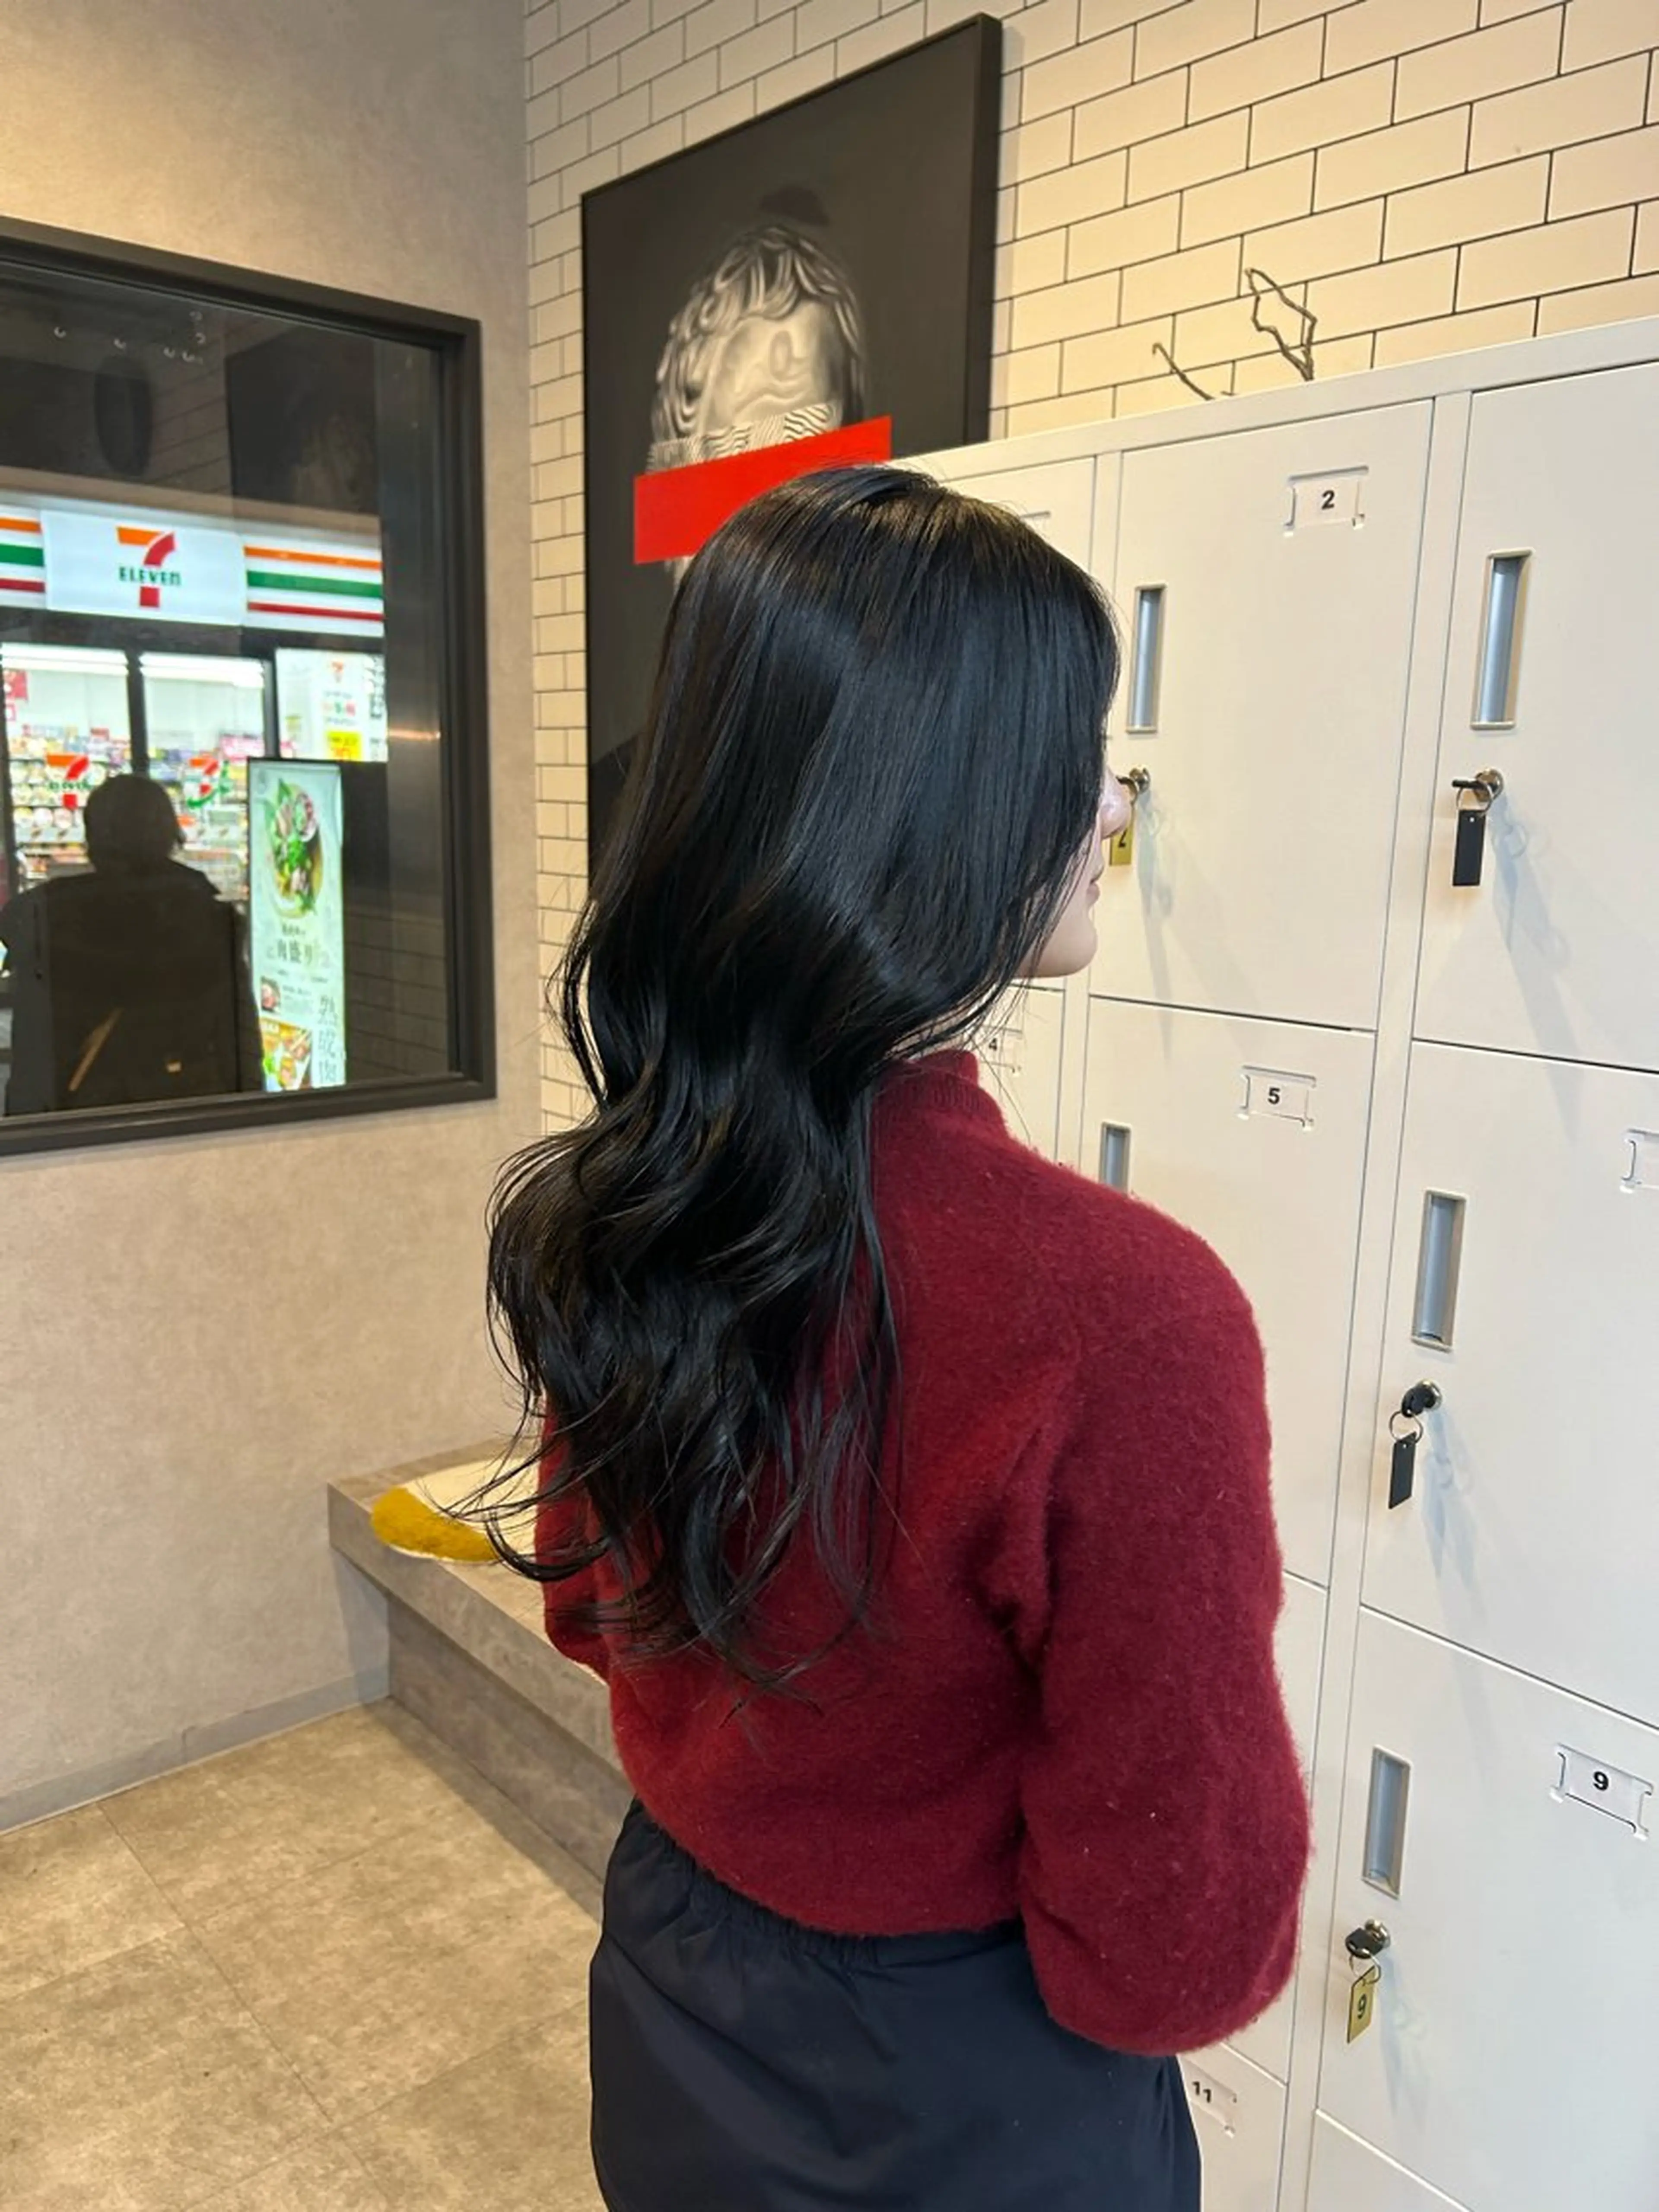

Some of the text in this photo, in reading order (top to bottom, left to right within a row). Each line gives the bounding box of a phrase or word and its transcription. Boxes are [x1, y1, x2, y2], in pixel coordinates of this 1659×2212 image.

[1322, 489, 1335, 510] 2
[118, 527, 175, 607] 7
[988, 1037, 998, 1052] 4
[1267, 1087, 1281, 1105] 5
[1592, 1771, 1609, 1792] 9
[1357, 1993, 1367, 2020] 9
[1192, 2080, 1211, 2104] 11
